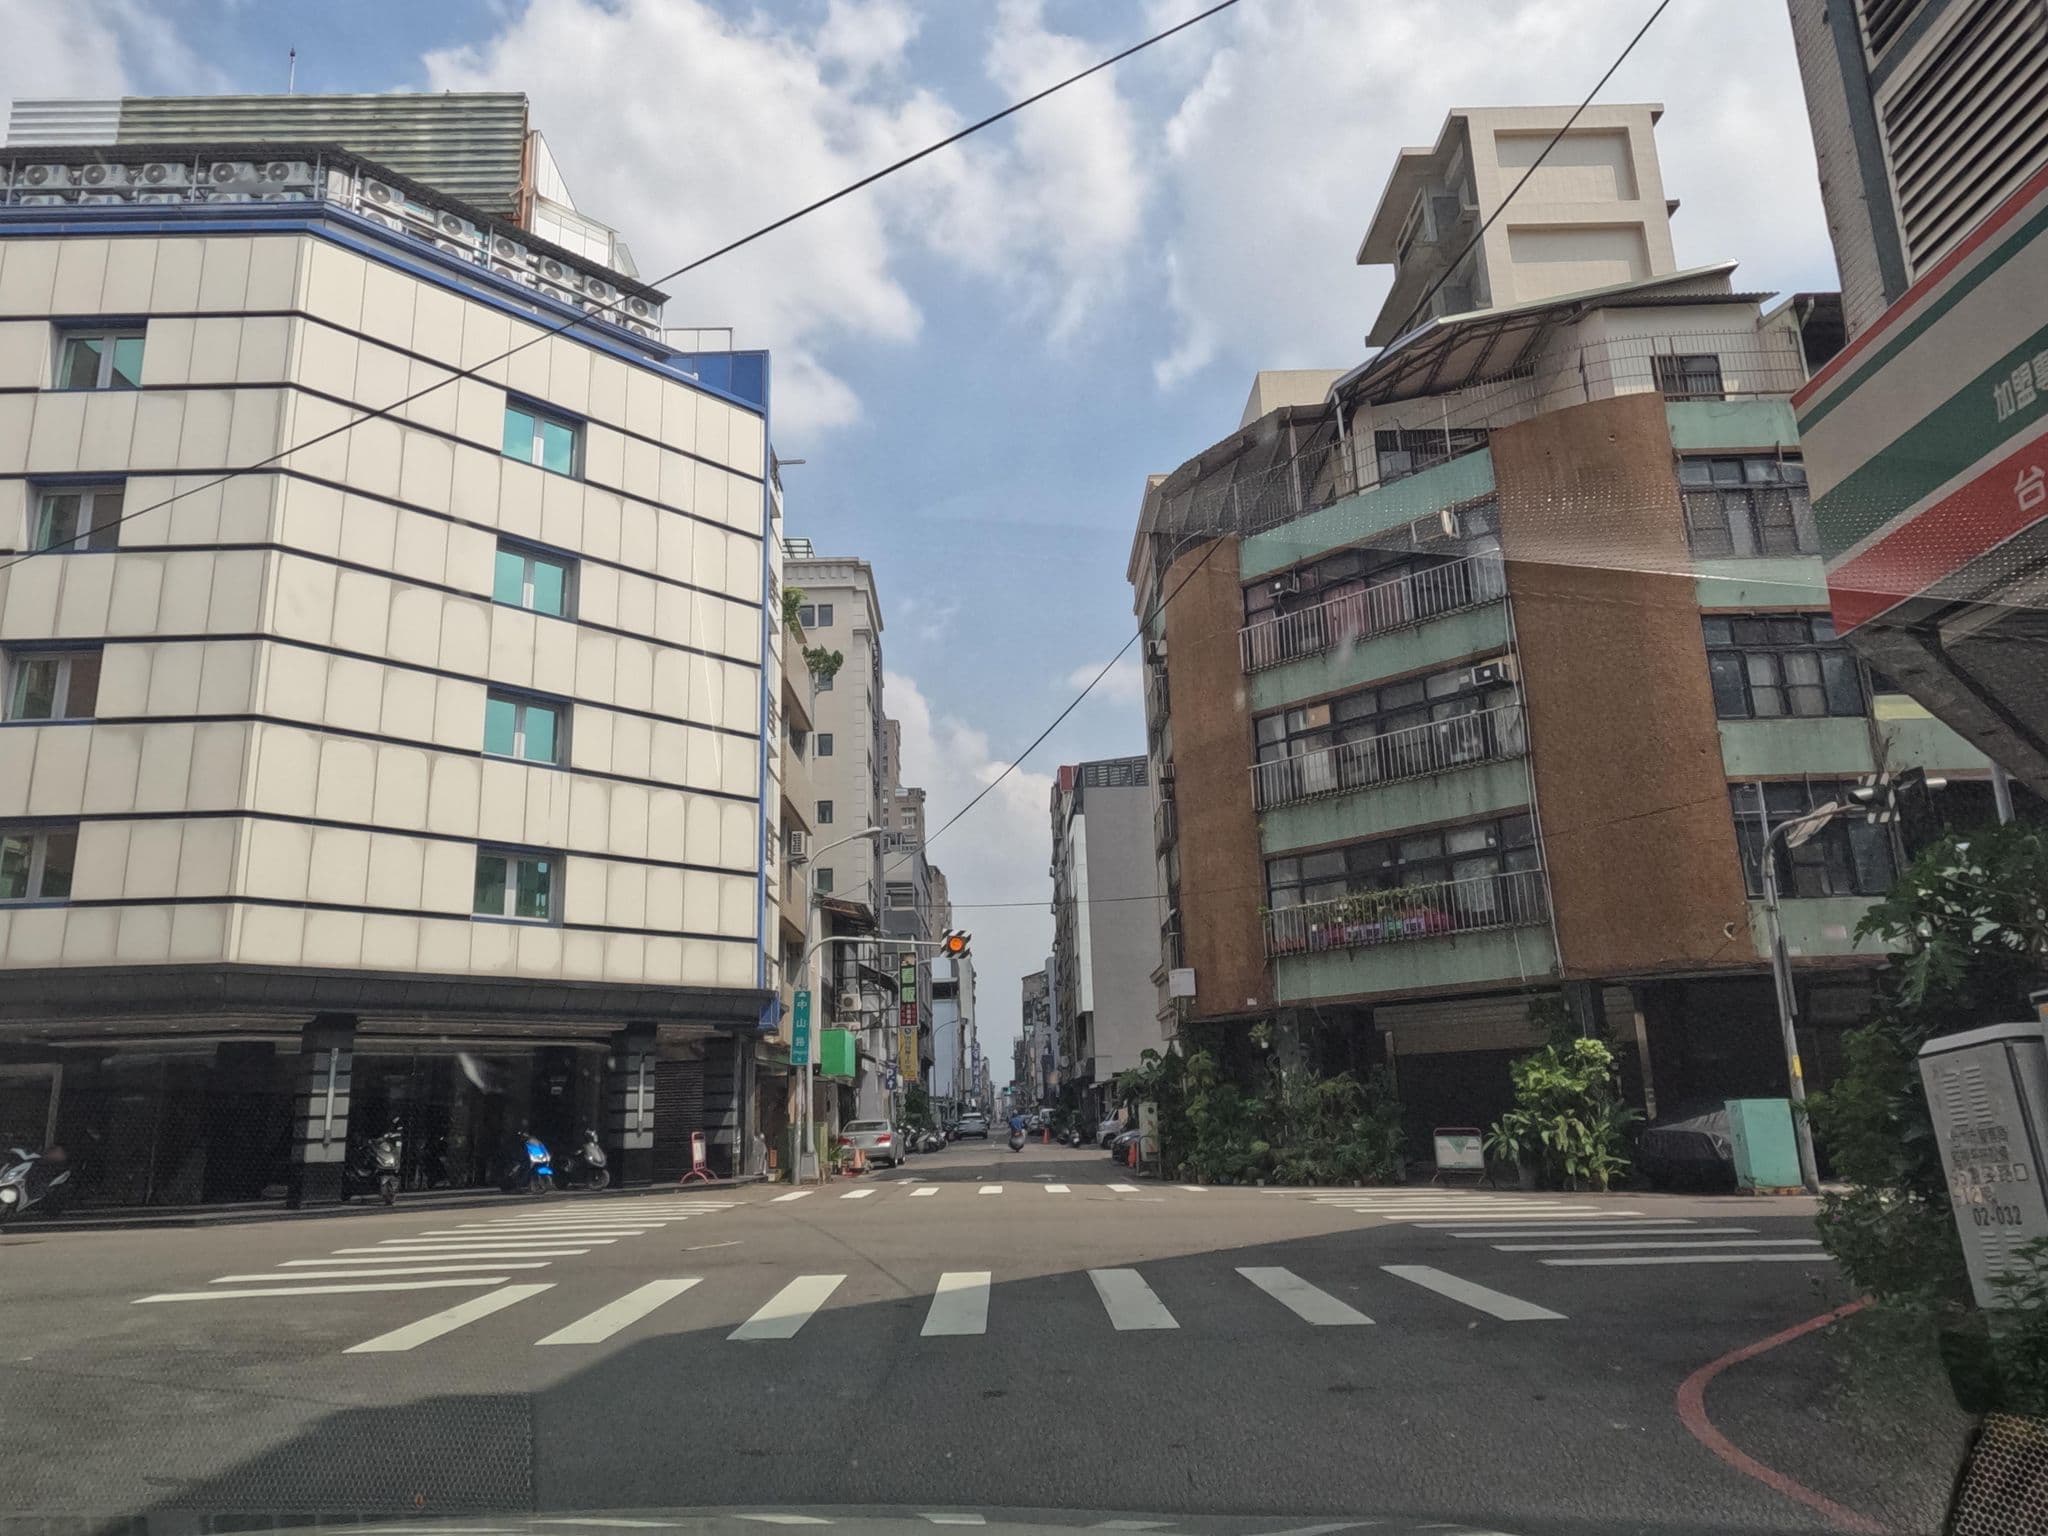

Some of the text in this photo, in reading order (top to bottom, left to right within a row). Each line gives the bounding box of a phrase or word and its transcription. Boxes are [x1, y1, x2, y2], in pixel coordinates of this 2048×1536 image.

[2013, 464, 2047, 512] 台
[886, 1069, 894, 1080] P
[1973, 1205, 2023, 1227] 02-032
